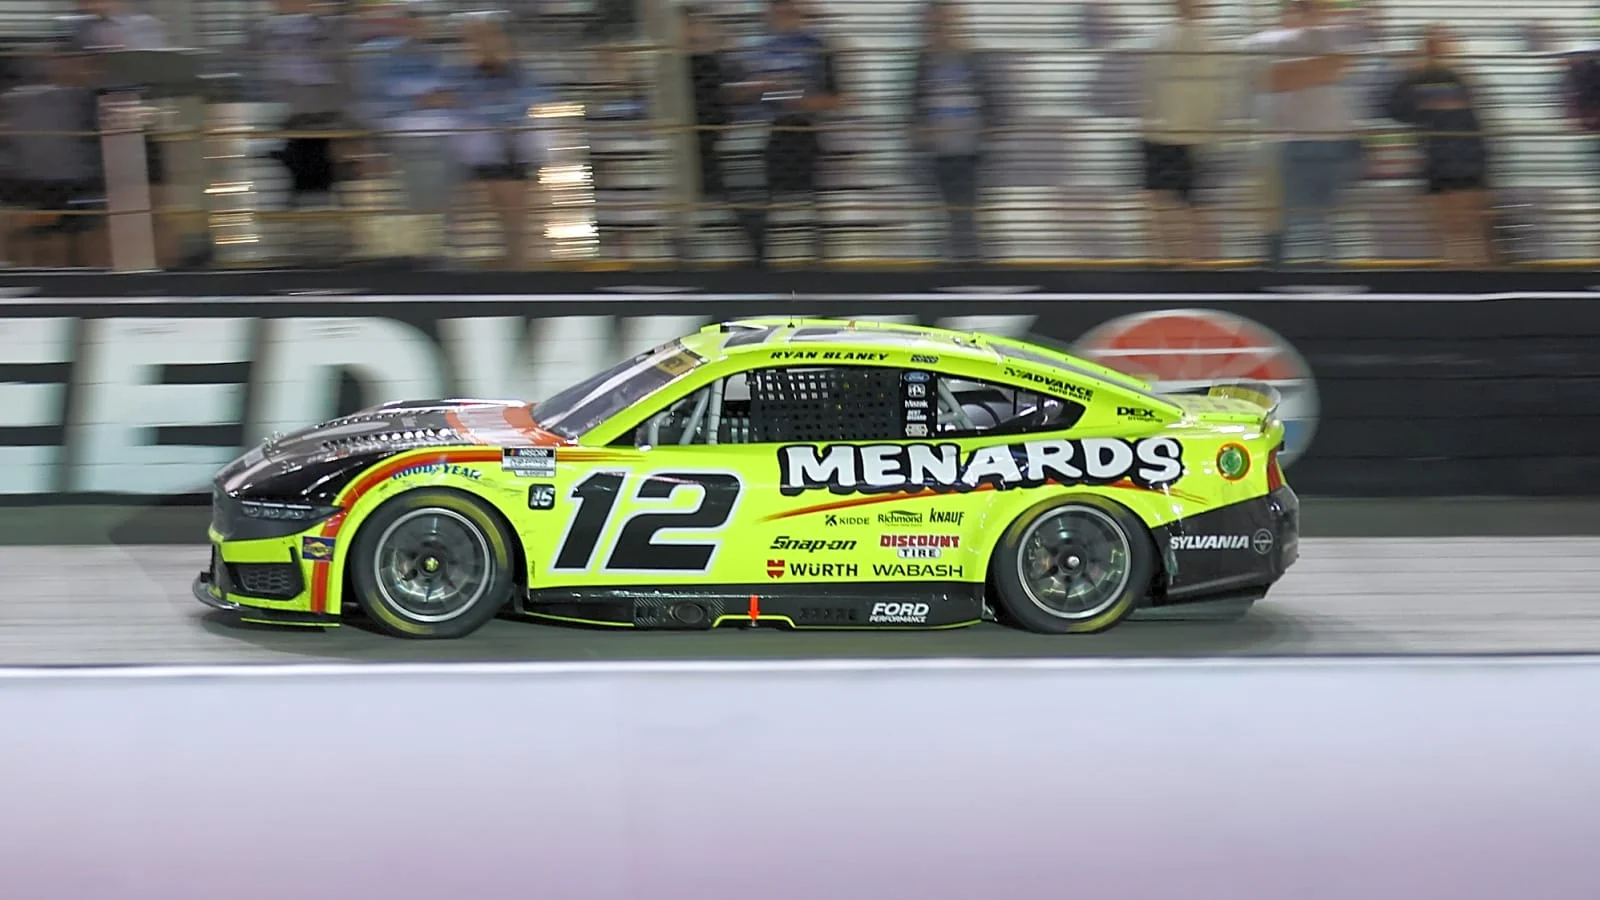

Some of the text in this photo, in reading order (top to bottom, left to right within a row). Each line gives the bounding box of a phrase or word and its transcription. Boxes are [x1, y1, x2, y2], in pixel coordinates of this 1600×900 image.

[770, 351, 889, 361] RYAN BLANEY
[1022, 373, 1094, 397] ADVANCE
[1048, 386, 1092, 402] AUTO PARTS
[1117, 406, 1155, 418] DEX
[779, 437, 1184, 492] MENARDS
[551, 469, 745, 573] 12
[839, 517, 870, 525] KIDDE
[878, 510, 922, 525] Richmond
[929, 508, 965, 526] KNAUF
[770, 536, 857, 553] Snap-on
[880, 535, 960, 548] DISCOUNT
[1170, 535, 1249, 550] SYLVANIA
[903, 548, 936, 558] TIRE
[790, 563, 858, 577] WÜRTH
[873, 564, 963, 577] WABASH
[872, 602, 930, 616] FORD
[869, 615, 927, 623] PERFORMANCE
